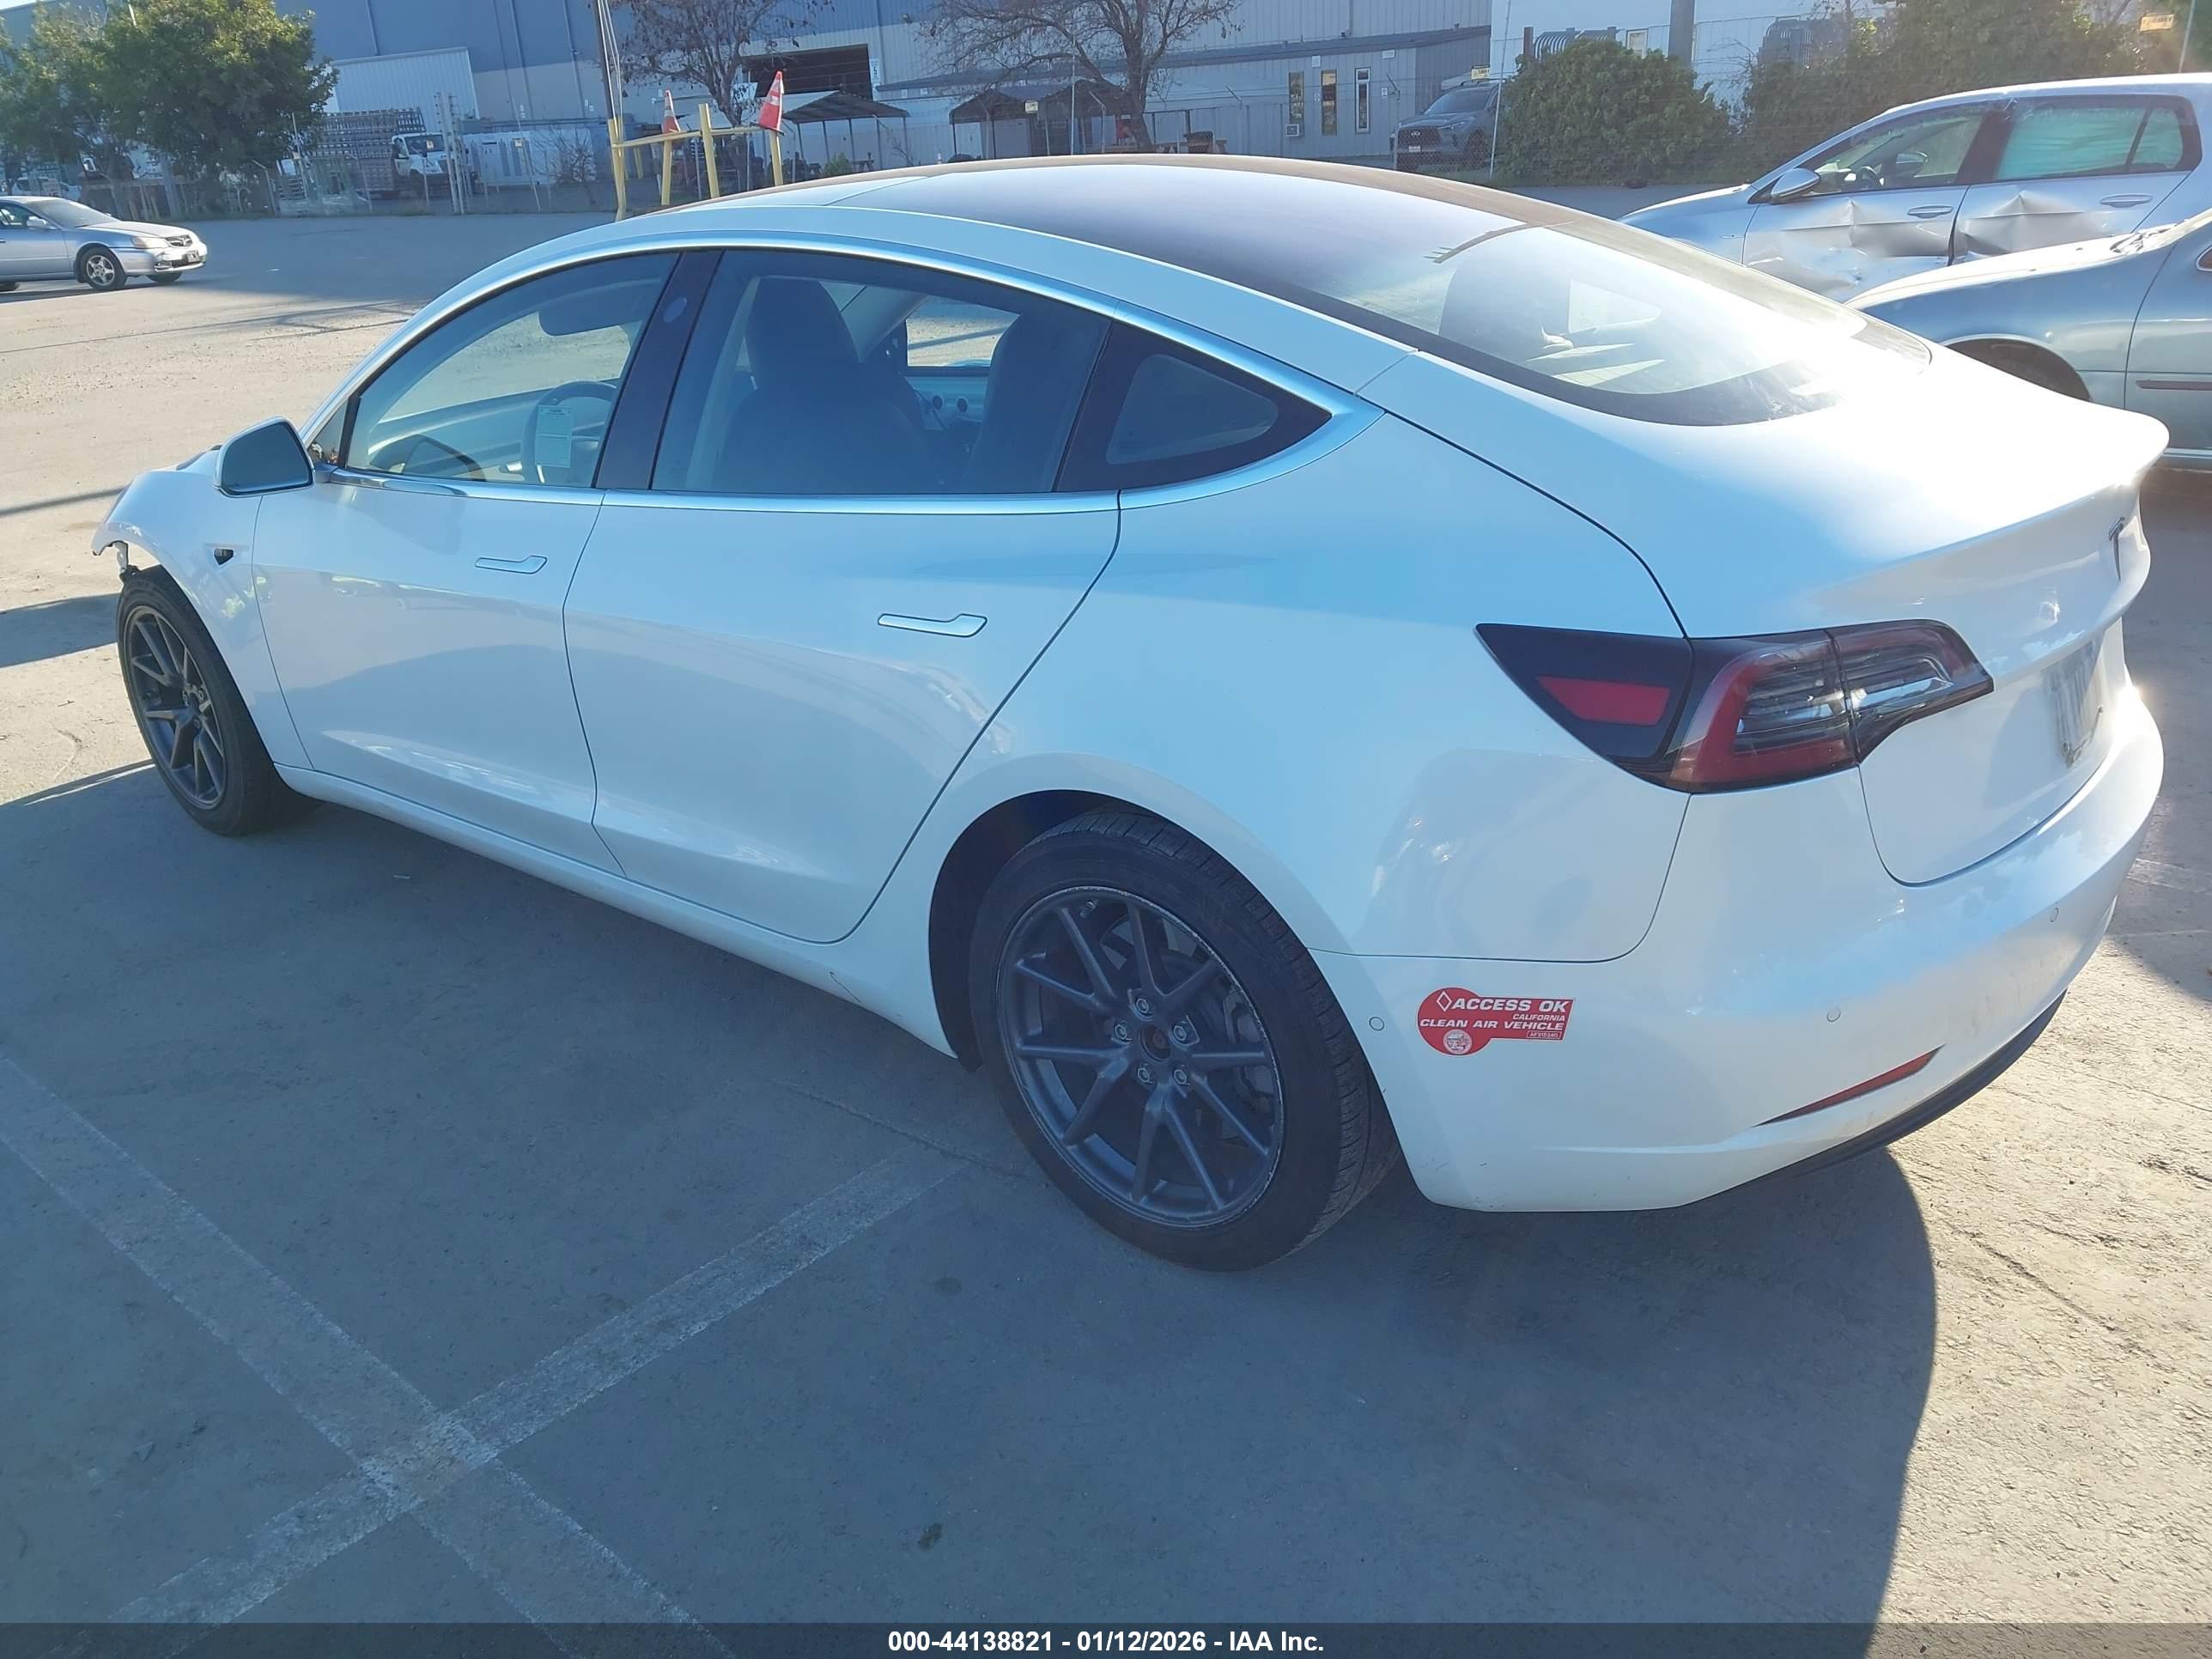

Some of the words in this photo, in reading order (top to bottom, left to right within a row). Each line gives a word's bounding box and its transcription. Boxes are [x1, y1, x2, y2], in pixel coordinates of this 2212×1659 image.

[1451, 998, 1532, 1012] ACCESS
[1539, 1000, 1570, 1012] OK
[1419, 1018, 1468, 1027] CLEAN
[1473, 1020, 1498, 1029] AIR
[1504, 1021, 1565, 1030] VEHICLE
